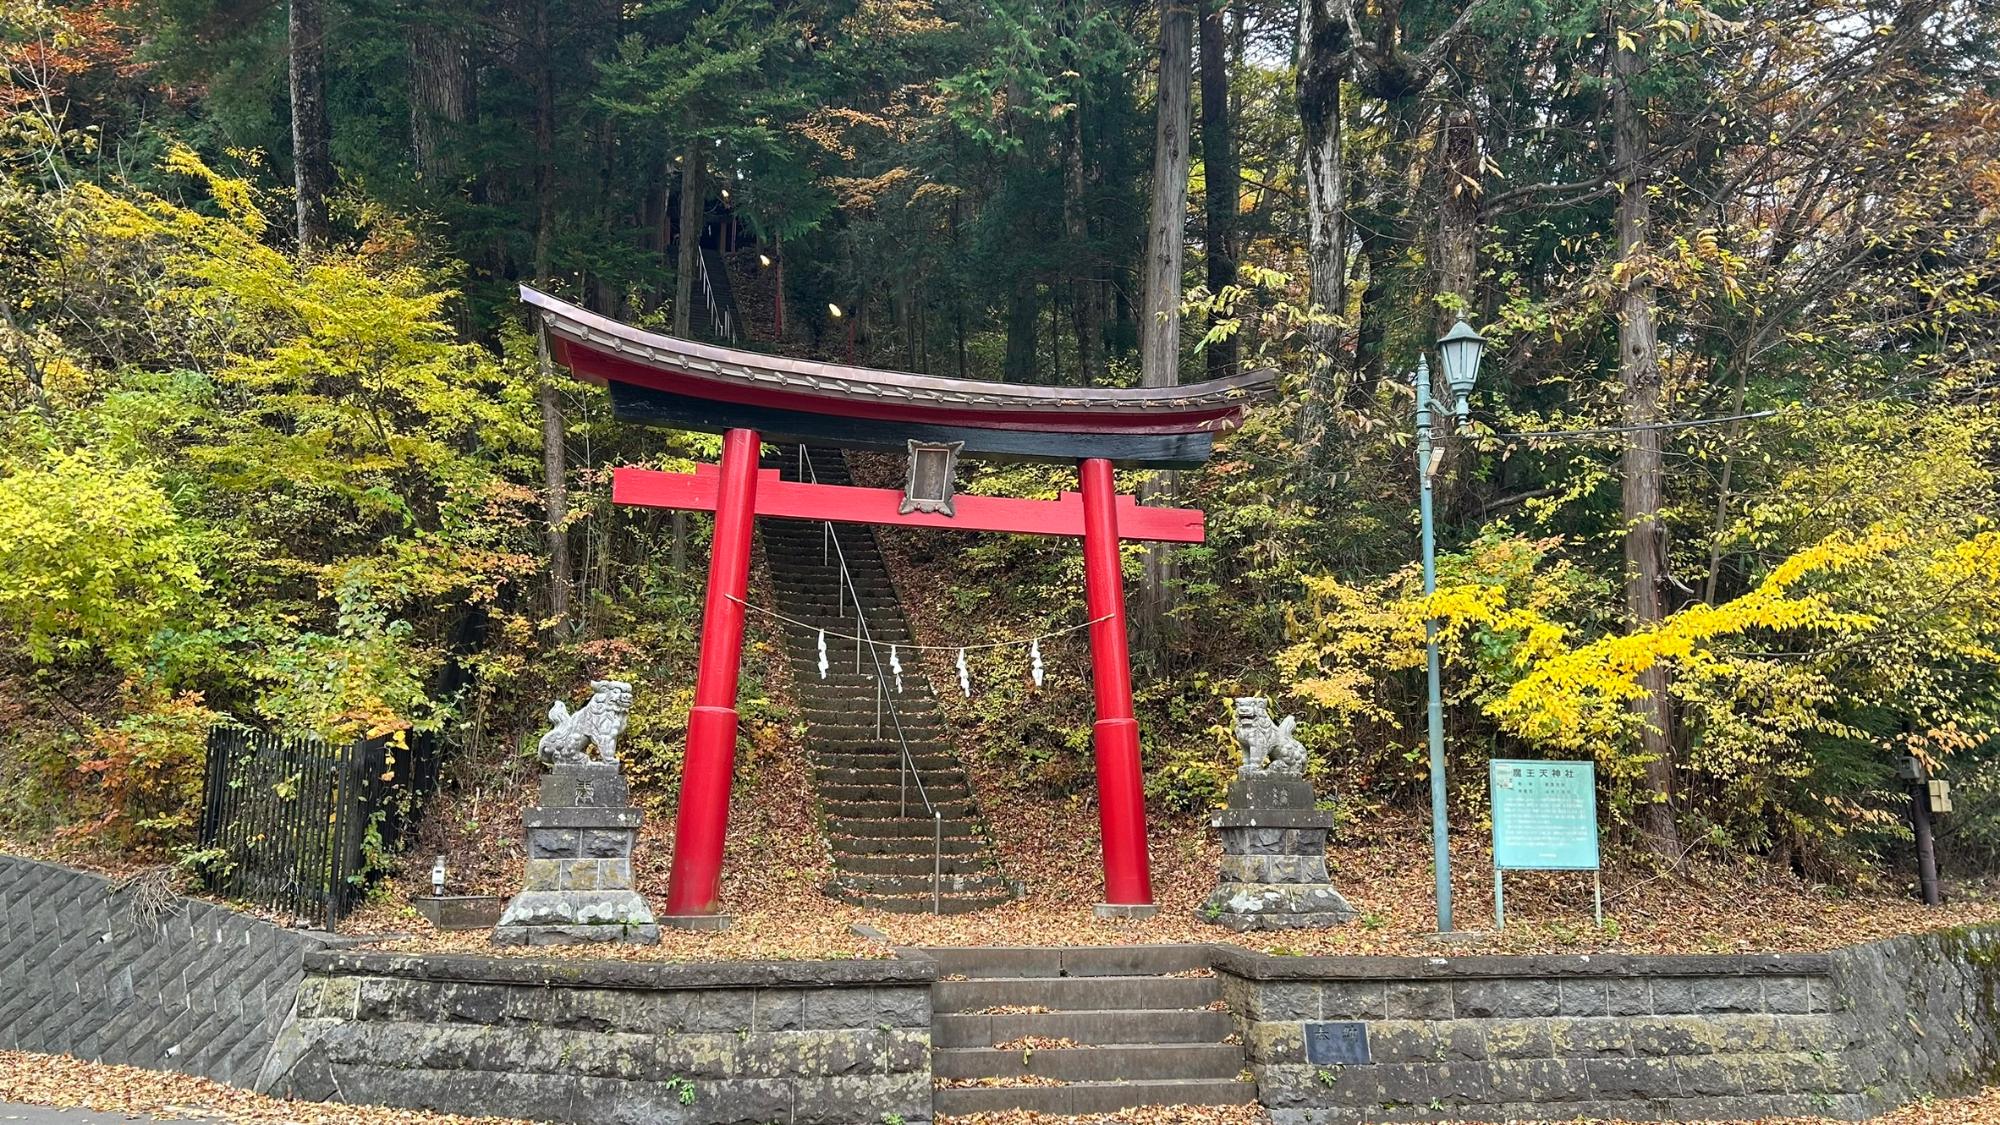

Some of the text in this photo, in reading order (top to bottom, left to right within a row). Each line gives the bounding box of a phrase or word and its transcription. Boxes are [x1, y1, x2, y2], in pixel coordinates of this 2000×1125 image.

[1512, 768, 1574, 778] 魔王天神社
